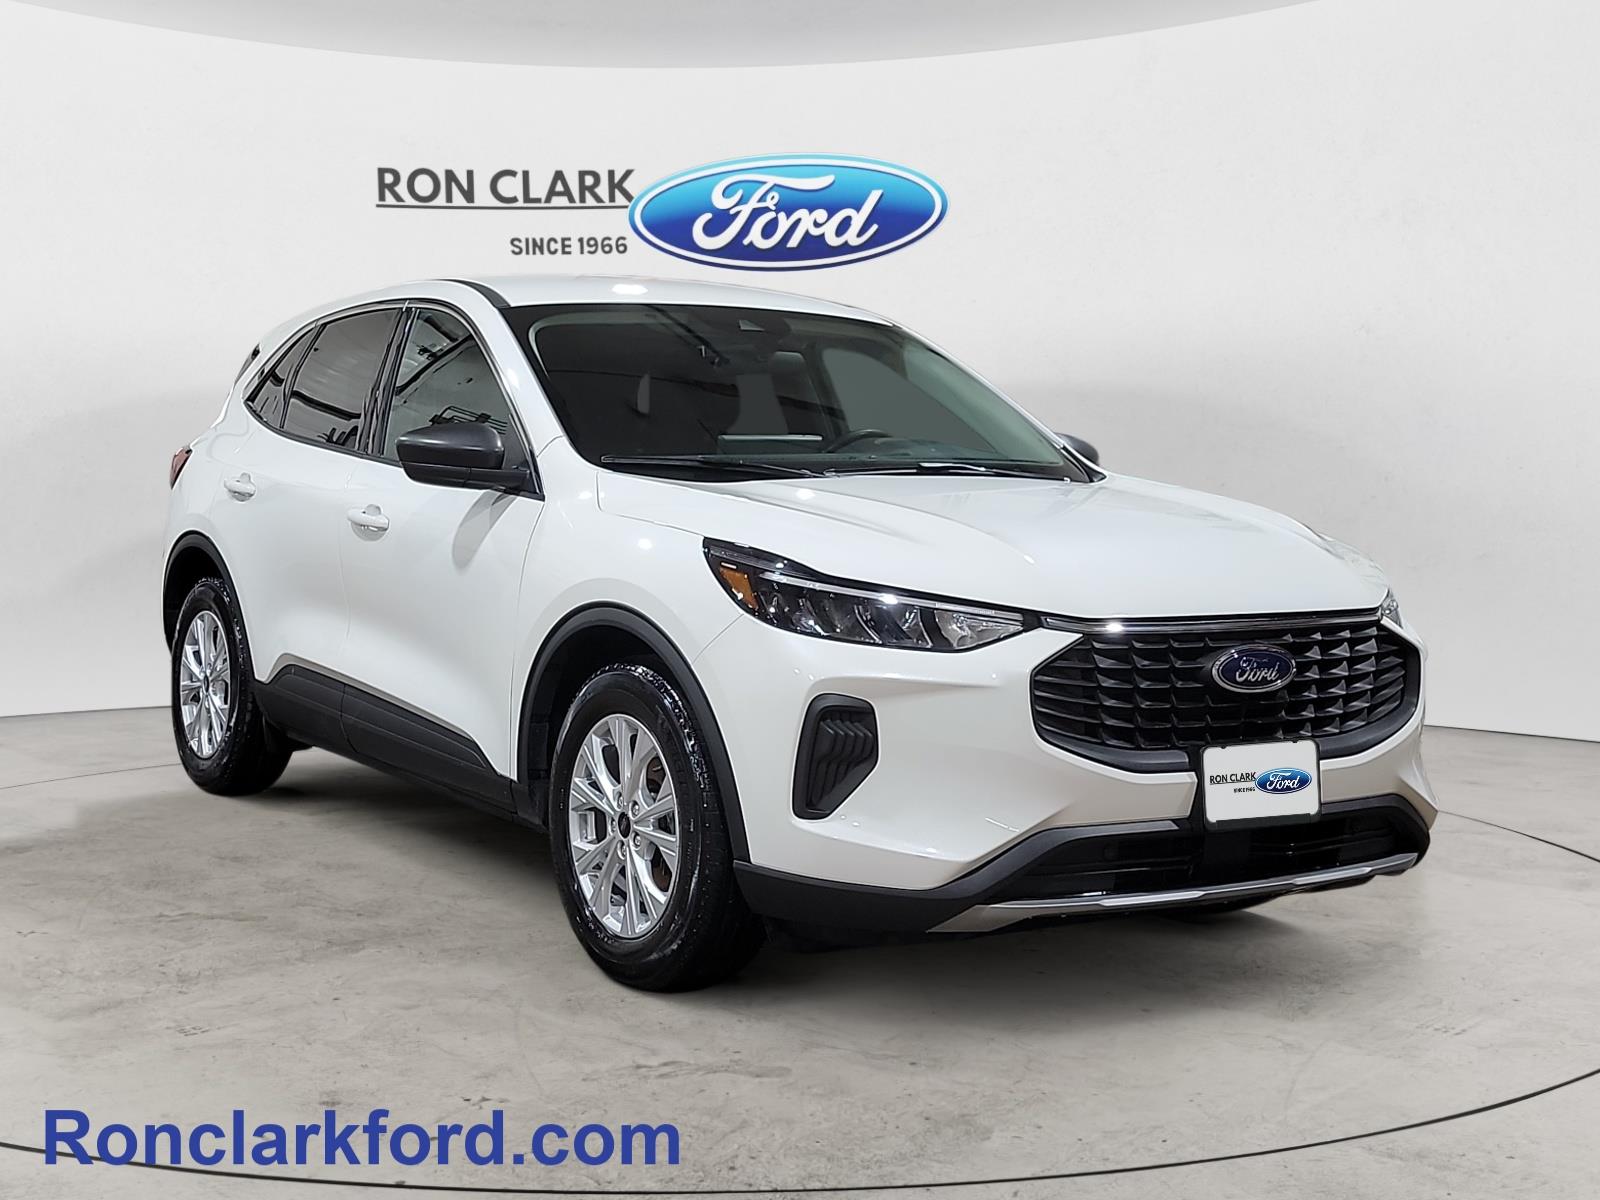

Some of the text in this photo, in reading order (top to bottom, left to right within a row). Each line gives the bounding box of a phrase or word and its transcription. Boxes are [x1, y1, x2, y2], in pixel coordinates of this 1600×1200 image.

[377, 167, 635, 204] RON CLARK
[692, 174, 883, 250] Ford
[510, 236, 628, 255] SINCE 1966
[1236, 656, 1280, 682] Ford
[1209, 772, 1256, 783] RON CLARK
[1266, 771, 1300, 790] Ford
